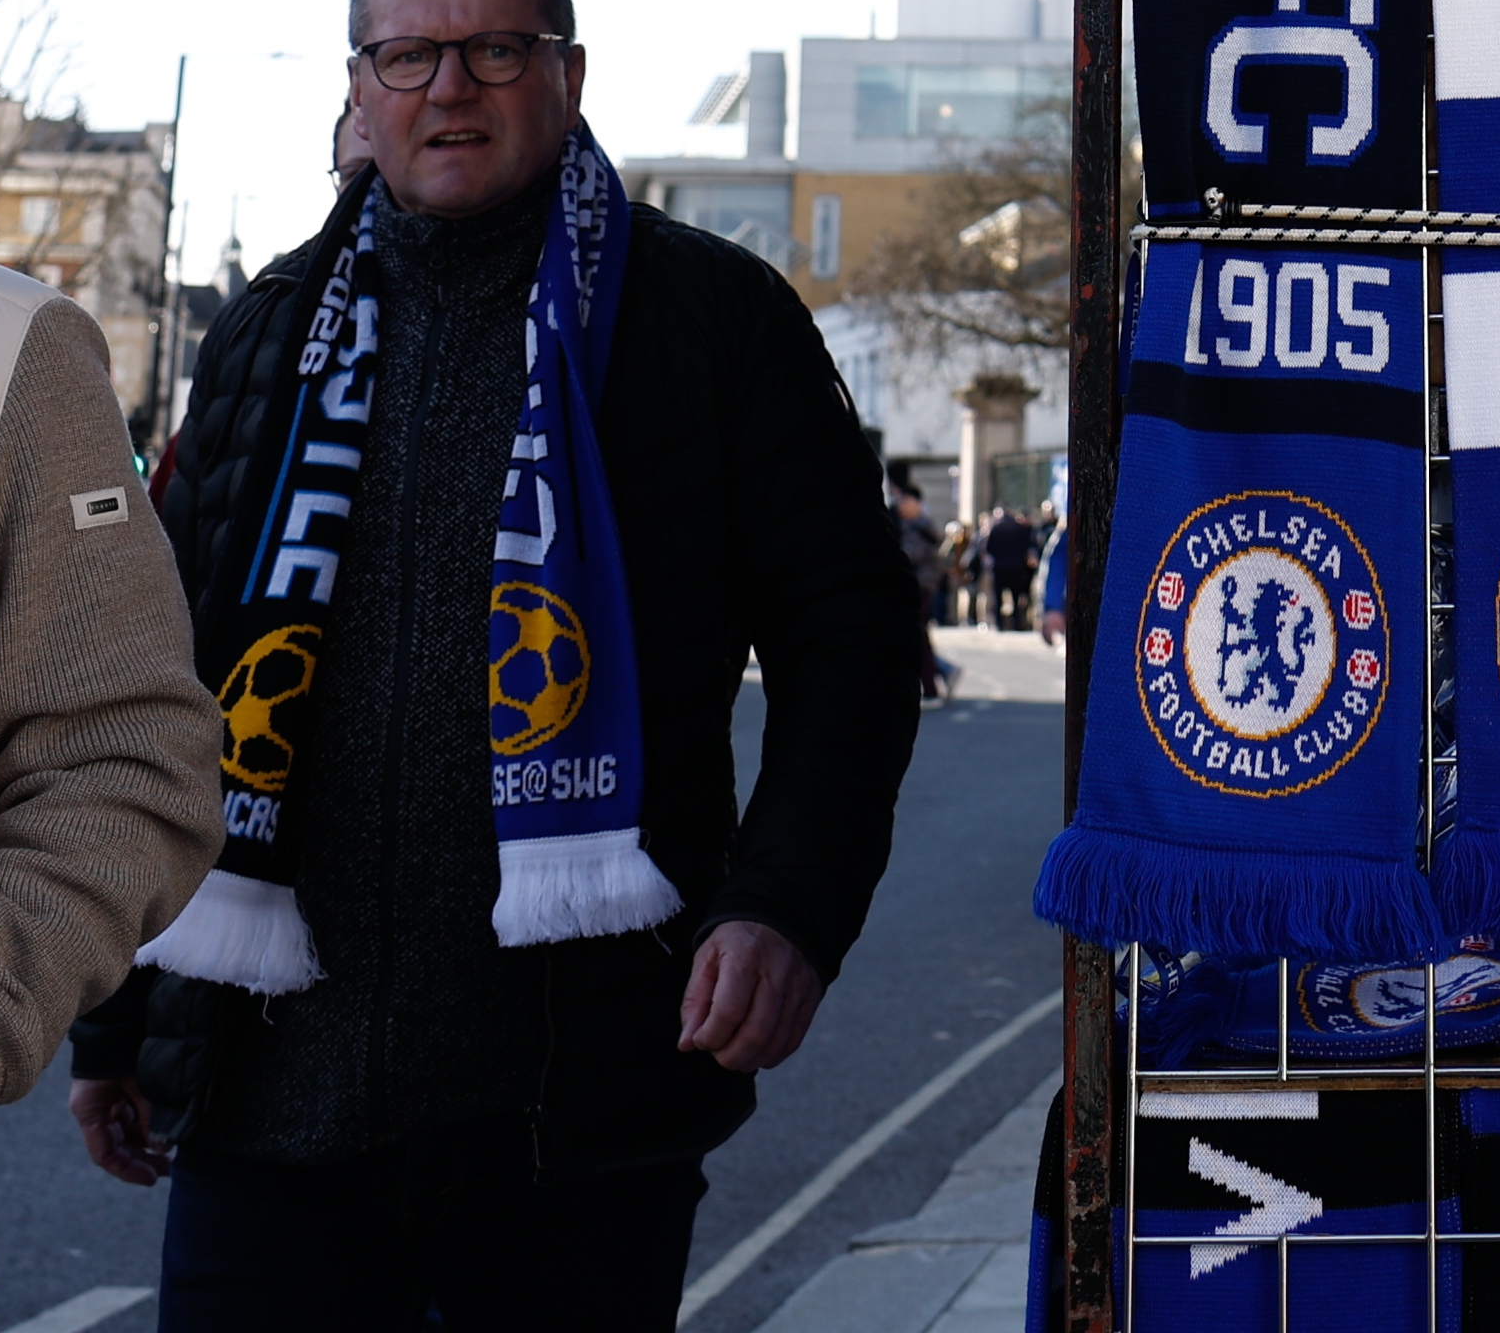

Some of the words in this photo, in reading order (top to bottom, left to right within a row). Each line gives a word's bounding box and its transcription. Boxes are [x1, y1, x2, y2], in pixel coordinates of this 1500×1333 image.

[1184, 259, 1390, 373] 1905
[1186, 509, 1342, 580] CHELSEA
[1148, 669, 1290, 780] FOOTBALL
[1293, 689, 1370, 764] CLUB
